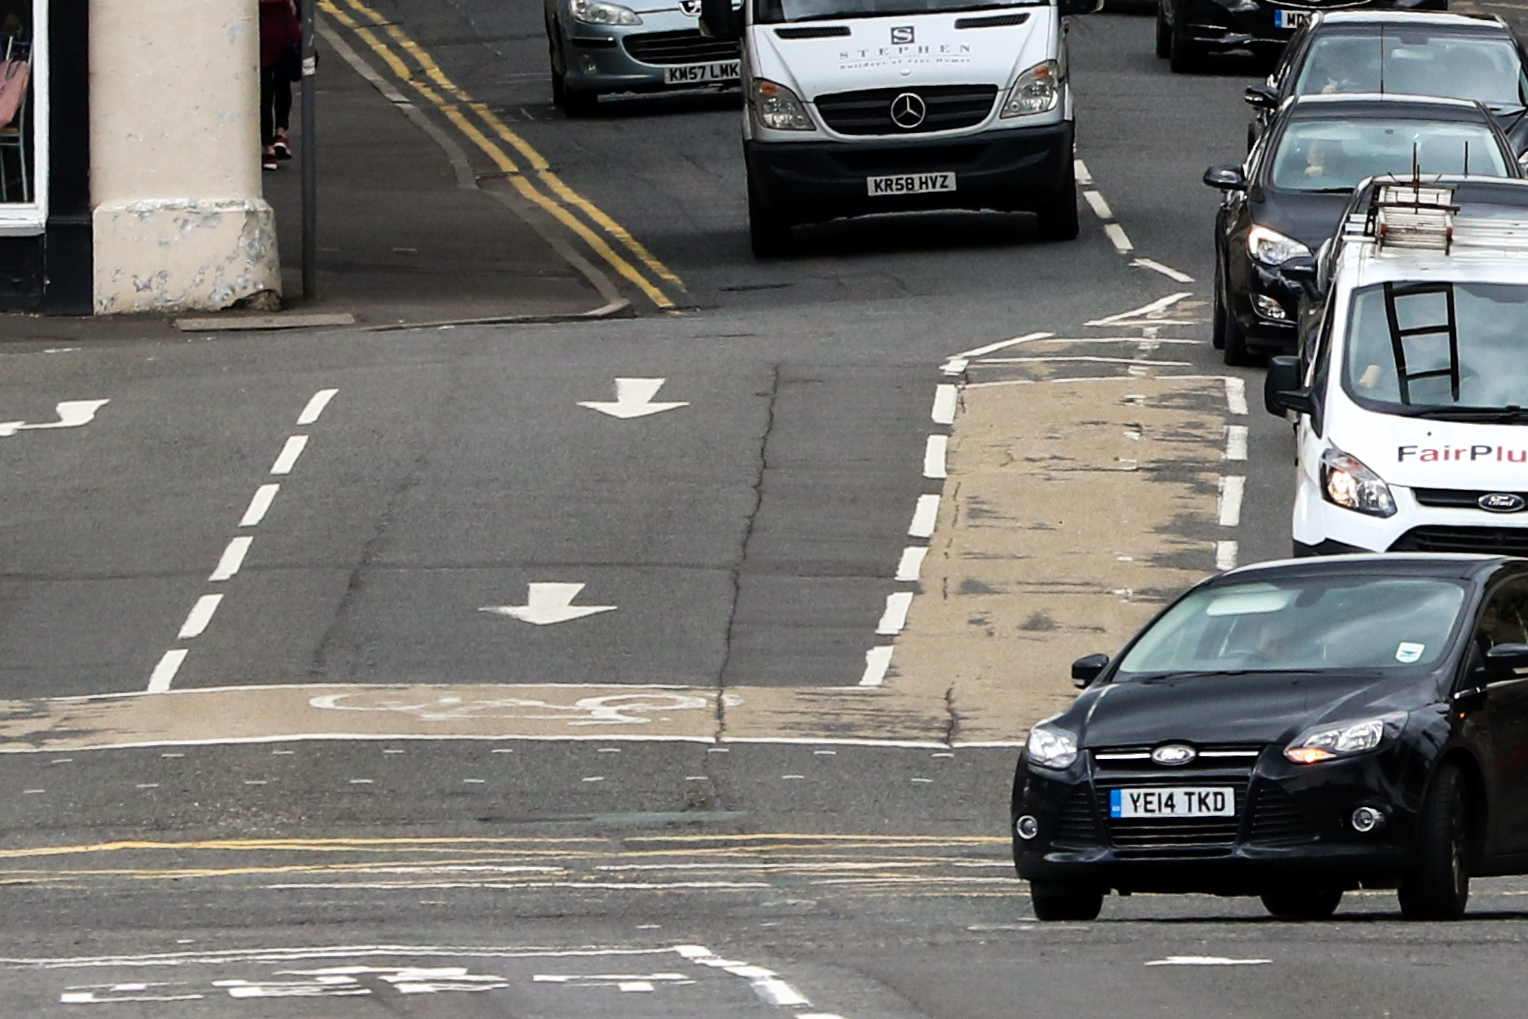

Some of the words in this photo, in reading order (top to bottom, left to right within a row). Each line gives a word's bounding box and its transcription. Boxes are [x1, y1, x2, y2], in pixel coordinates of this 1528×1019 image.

[839, 44, 971, 60] STEPHEN
[873, 177, 915, 193] KR58
[918, 174, 949, 191] HVZ
[1129, 791, 1176, 814] YE14
[1183, 791, 1226, 813] TKD
